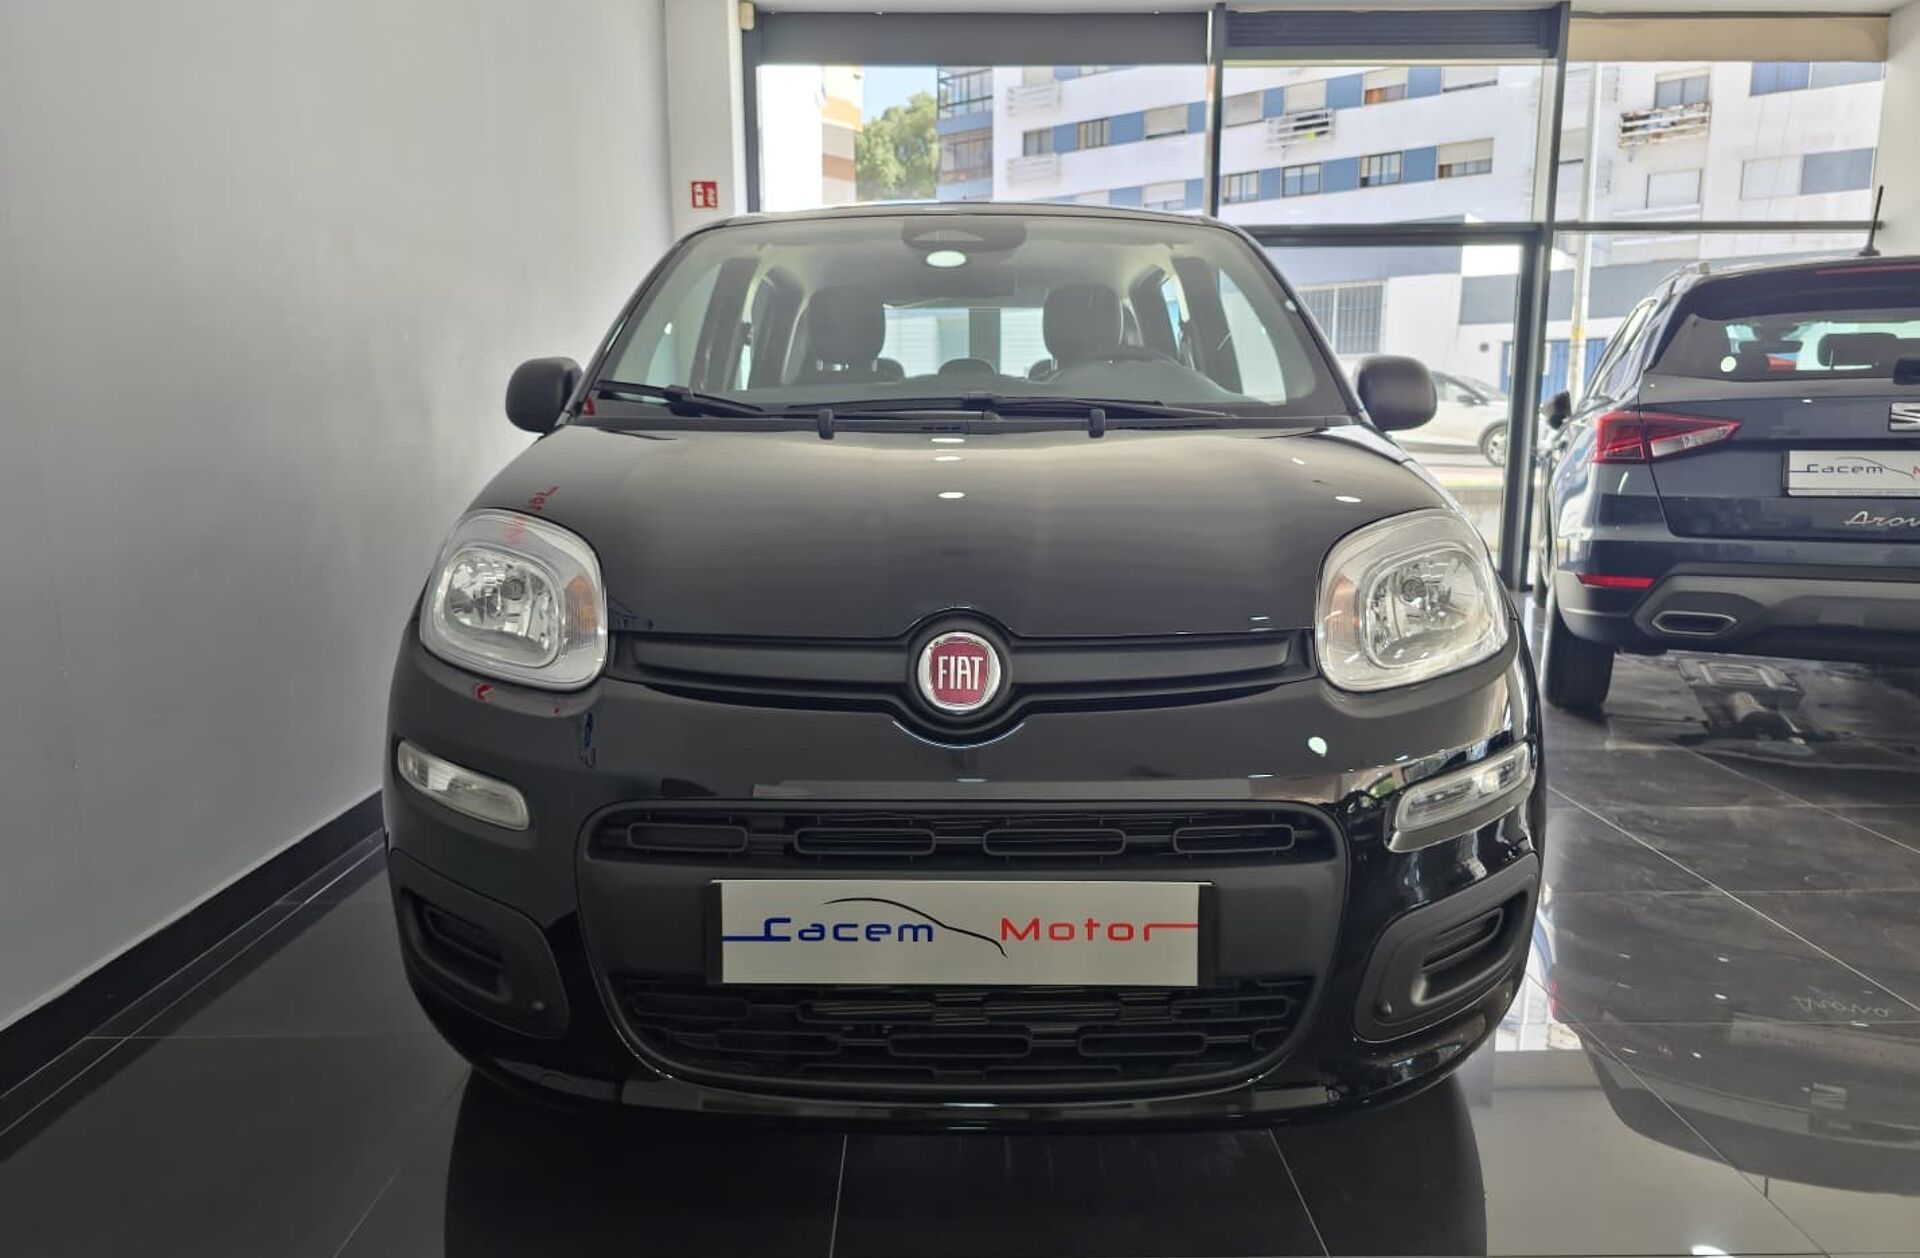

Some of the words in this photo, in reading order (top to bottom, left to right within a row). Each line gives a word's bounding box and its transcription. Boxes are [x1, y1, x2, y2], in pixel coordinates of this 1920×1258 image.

[1790, 463, 1883, 474] Cacem
[938, 655, 984, 691] FIAT
[723, 917, 934, 942] Cacem
[1000, 917, 1198, 941] Motor
